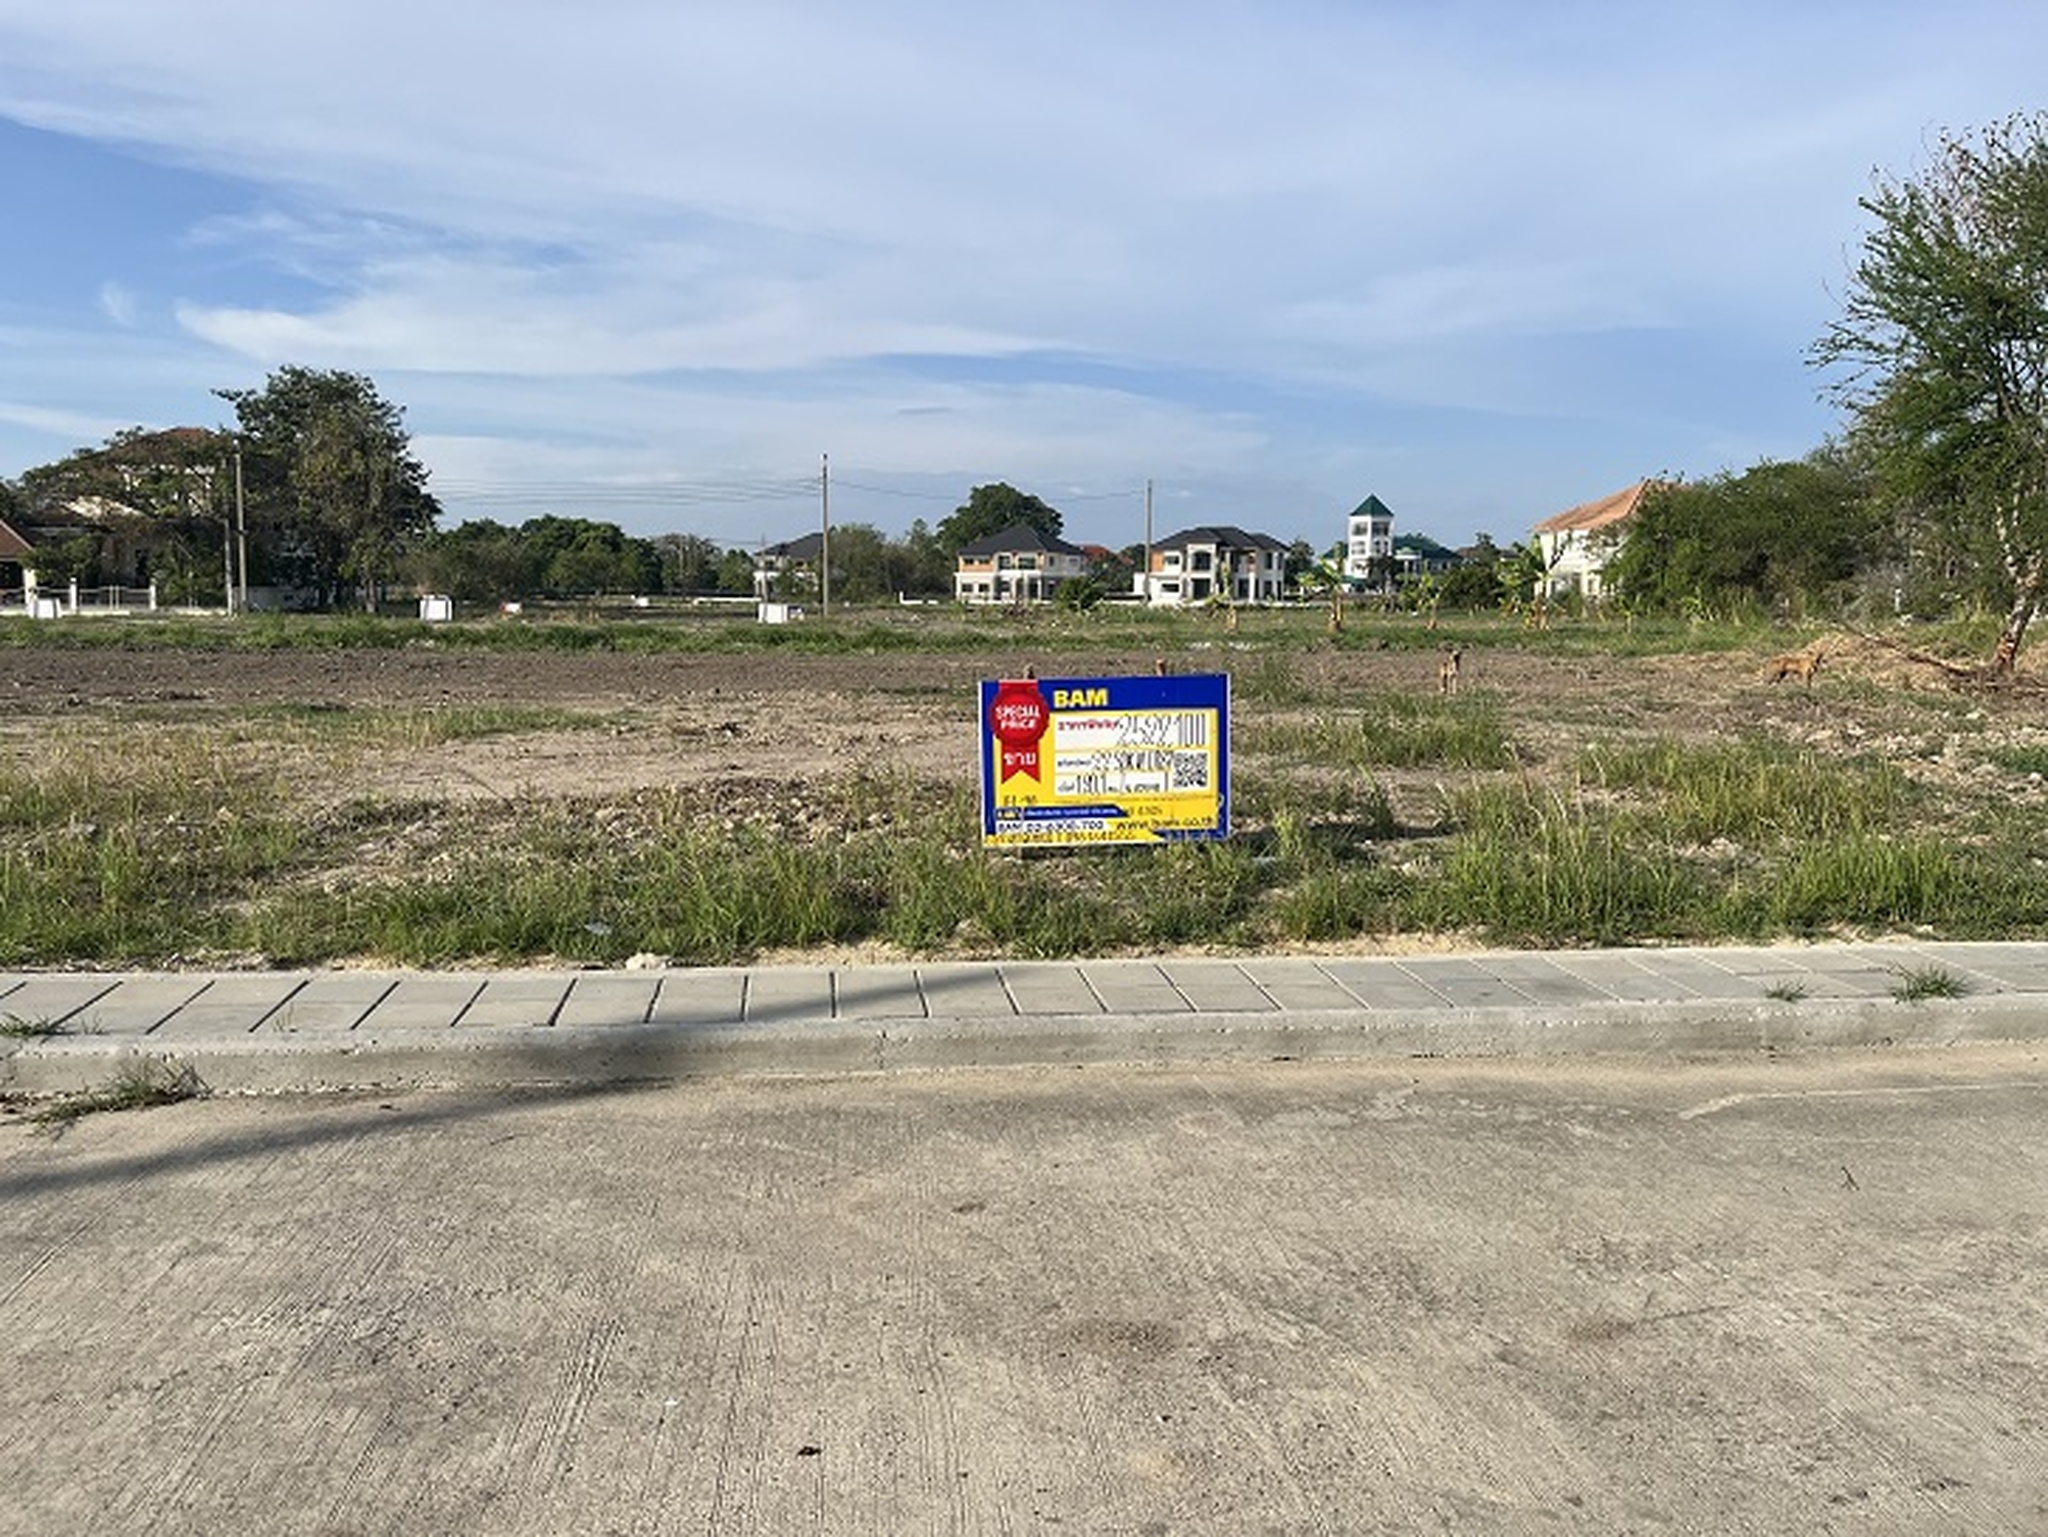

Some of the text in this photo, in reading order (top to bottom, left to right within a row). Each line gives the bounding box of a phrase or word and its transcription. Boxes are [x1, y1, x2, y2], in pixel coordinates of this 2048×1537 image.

[1053, 688, 1108, 709] BAM
[995, 704, 1041, 721] SPECIAL
[1000, 718, 1036, 730] PRICE
[1003, 751, 1037, 766] ขาย
